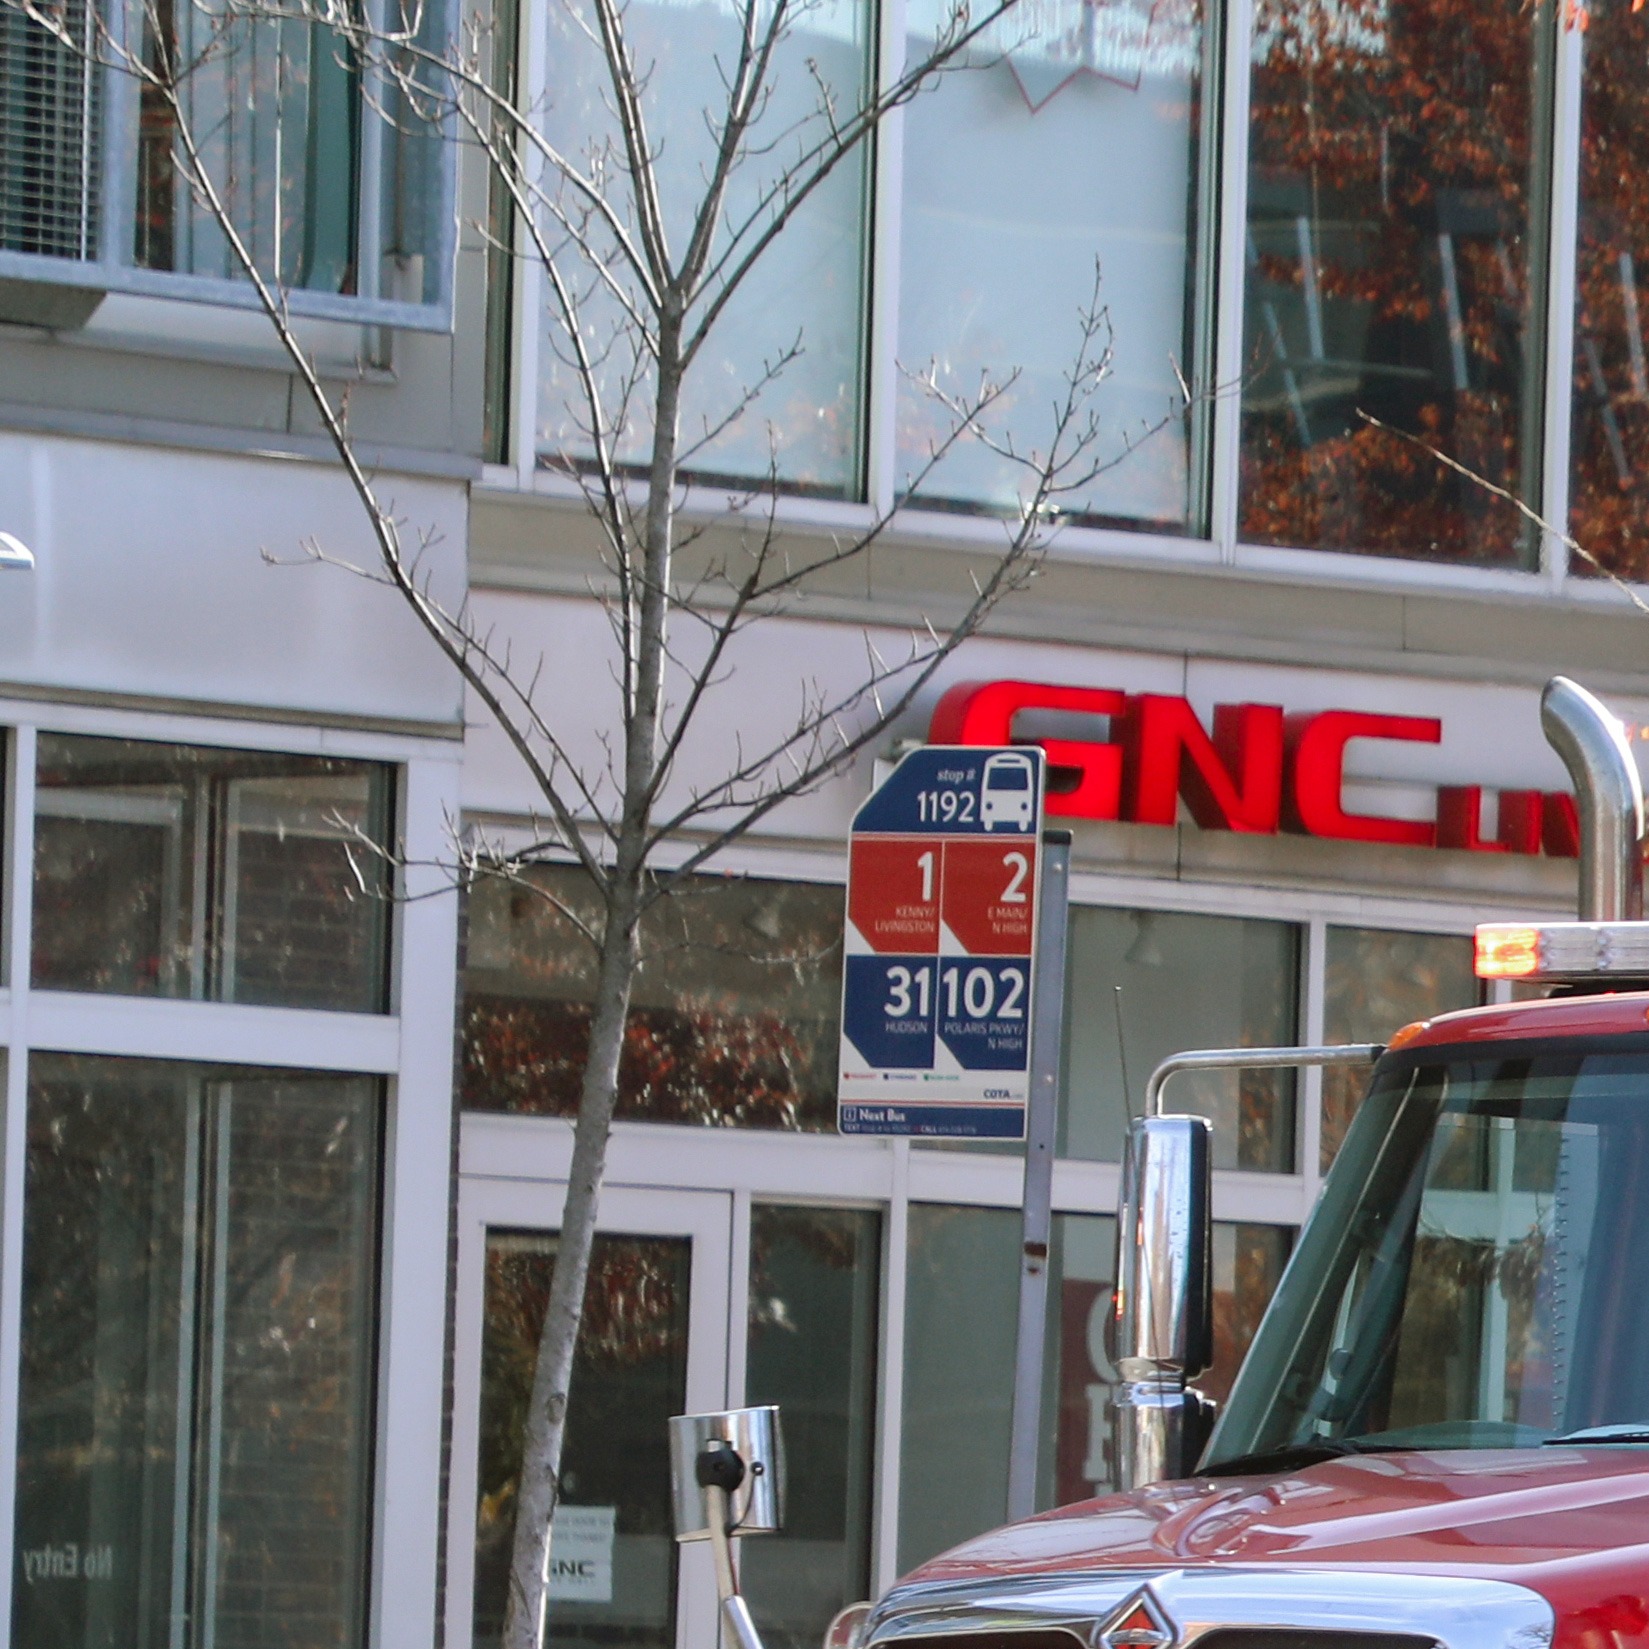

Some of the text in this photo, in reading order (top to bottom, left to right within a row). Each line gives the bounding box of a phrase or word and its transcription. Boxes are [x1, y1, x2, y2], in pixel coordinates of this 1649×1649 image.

[930, 680, 1441, 846] GNC
[937, 768, 964, 783] stop
[917, 791, 975, 822] 1192
[917, 851, 933, 902] 1
[1001, 852, 1028, 903] 2
[896, 905, 935, 918] KENNY/
[875, 919, 935, 933] LIVINGSTON
[1002, 922, 1027, 933] HIGH
[883, 965, 930, 1017] 31
[943, 966, 1024, 1018] 102
[885, 1021, 928, 1033] HUDSON
[944, 1022, 987, 1035] POLARIS
[998, 1038, 1023, 1050] HIGH
[984, 1089, 1010, 1099] COTA
[859, 1108, 906, 1122] Next Bus
